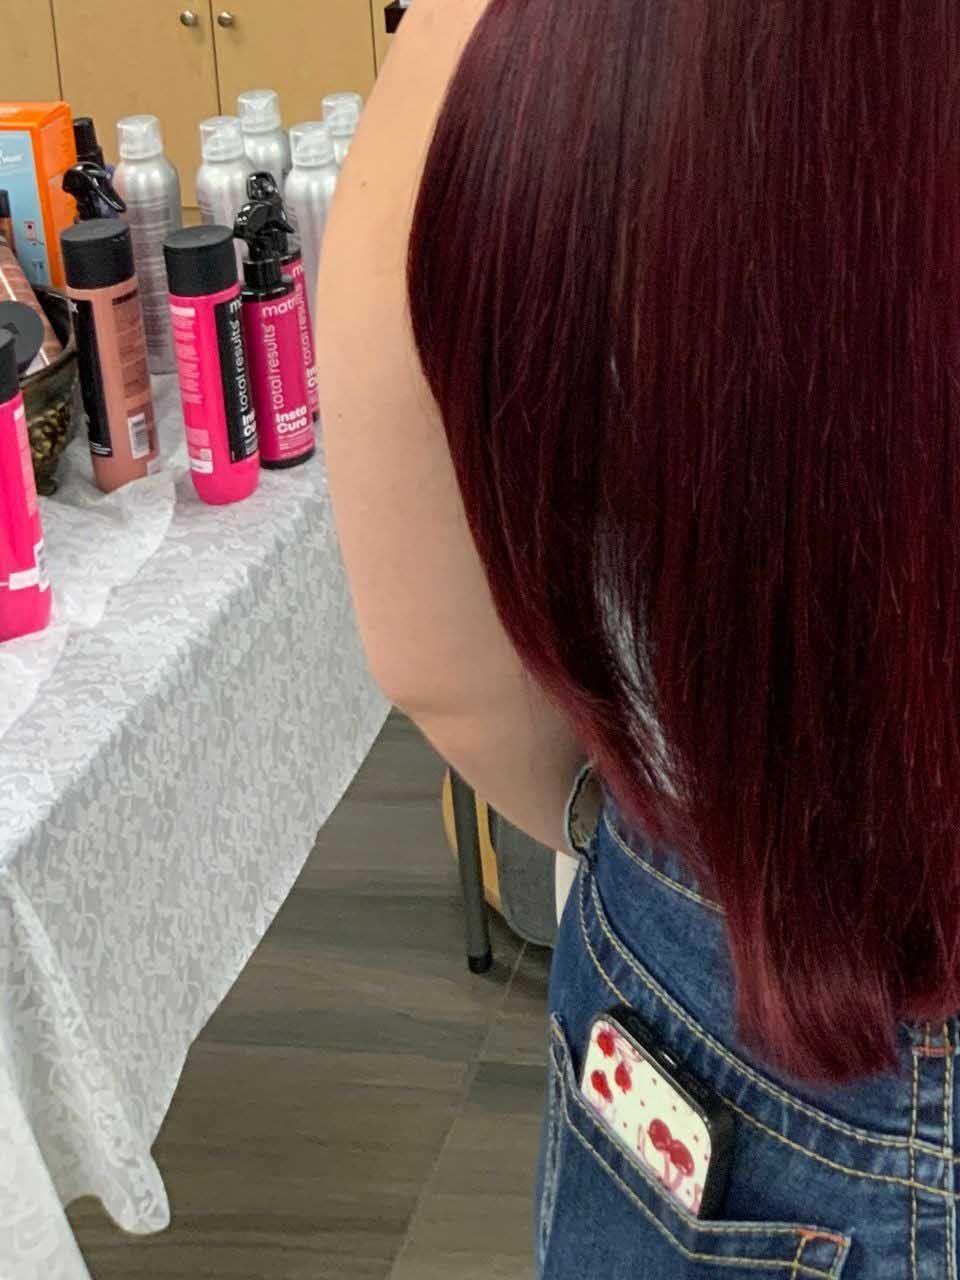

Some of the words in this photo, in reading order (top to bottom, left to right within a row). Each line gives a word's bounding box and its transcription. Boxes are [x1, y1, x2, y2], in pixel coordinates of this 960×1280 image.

[229, 320, 246, 375] results
[262, 322, 280, 372] results
[235, 376, 249, 413] total
[271, 375, 285, 410] total
[276, 417, 308, 435] Cure
